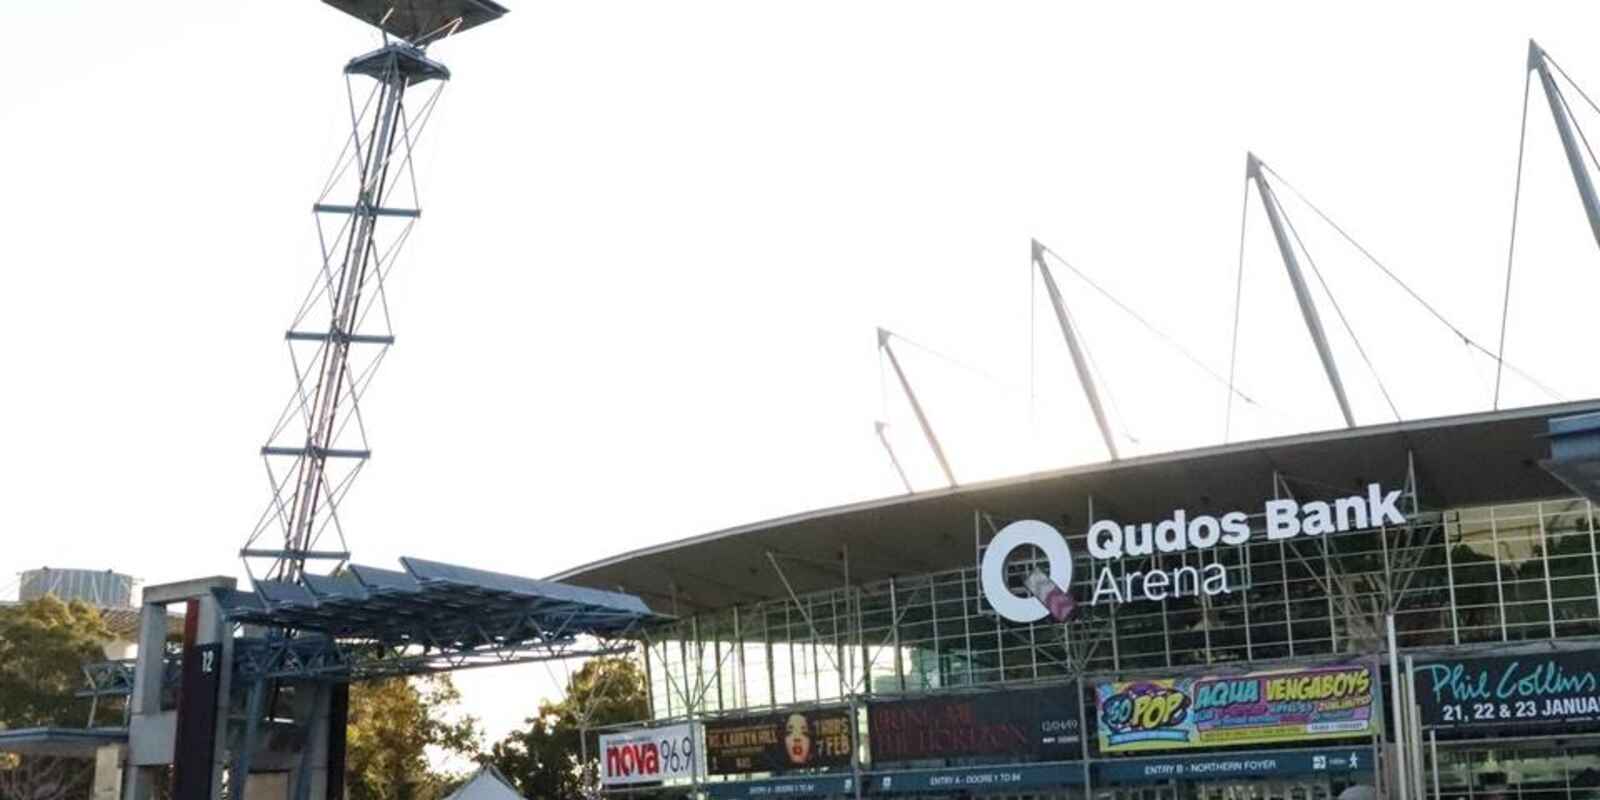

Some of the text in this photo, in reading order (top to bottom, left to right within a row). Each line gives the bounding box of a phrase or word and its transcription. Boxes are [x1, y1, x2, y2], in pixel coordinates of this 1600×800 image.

[1087, 483, 1406, 561] Qudos Bank
[1091, 561, 1230, 605] Arena
[202, 650, 214, 673] 12
[1197, 680, 1259, 708] AQUA
[1266, 670, 1370, 701] VENGABOYS
[1414, 661, 1596, 702] Phil Collins
[1131, 692, 1184, 729] POP
[1442, 696, 1600, 722] 21, 22 & 23 JANUA
[606, 736, 693, 778] nova 96.9
[1144, 764, 1174, 775] ENTRY
[1191, 761, 1242, 773] NORTHERN
[1244, 759, 1276, 770] FOYER
